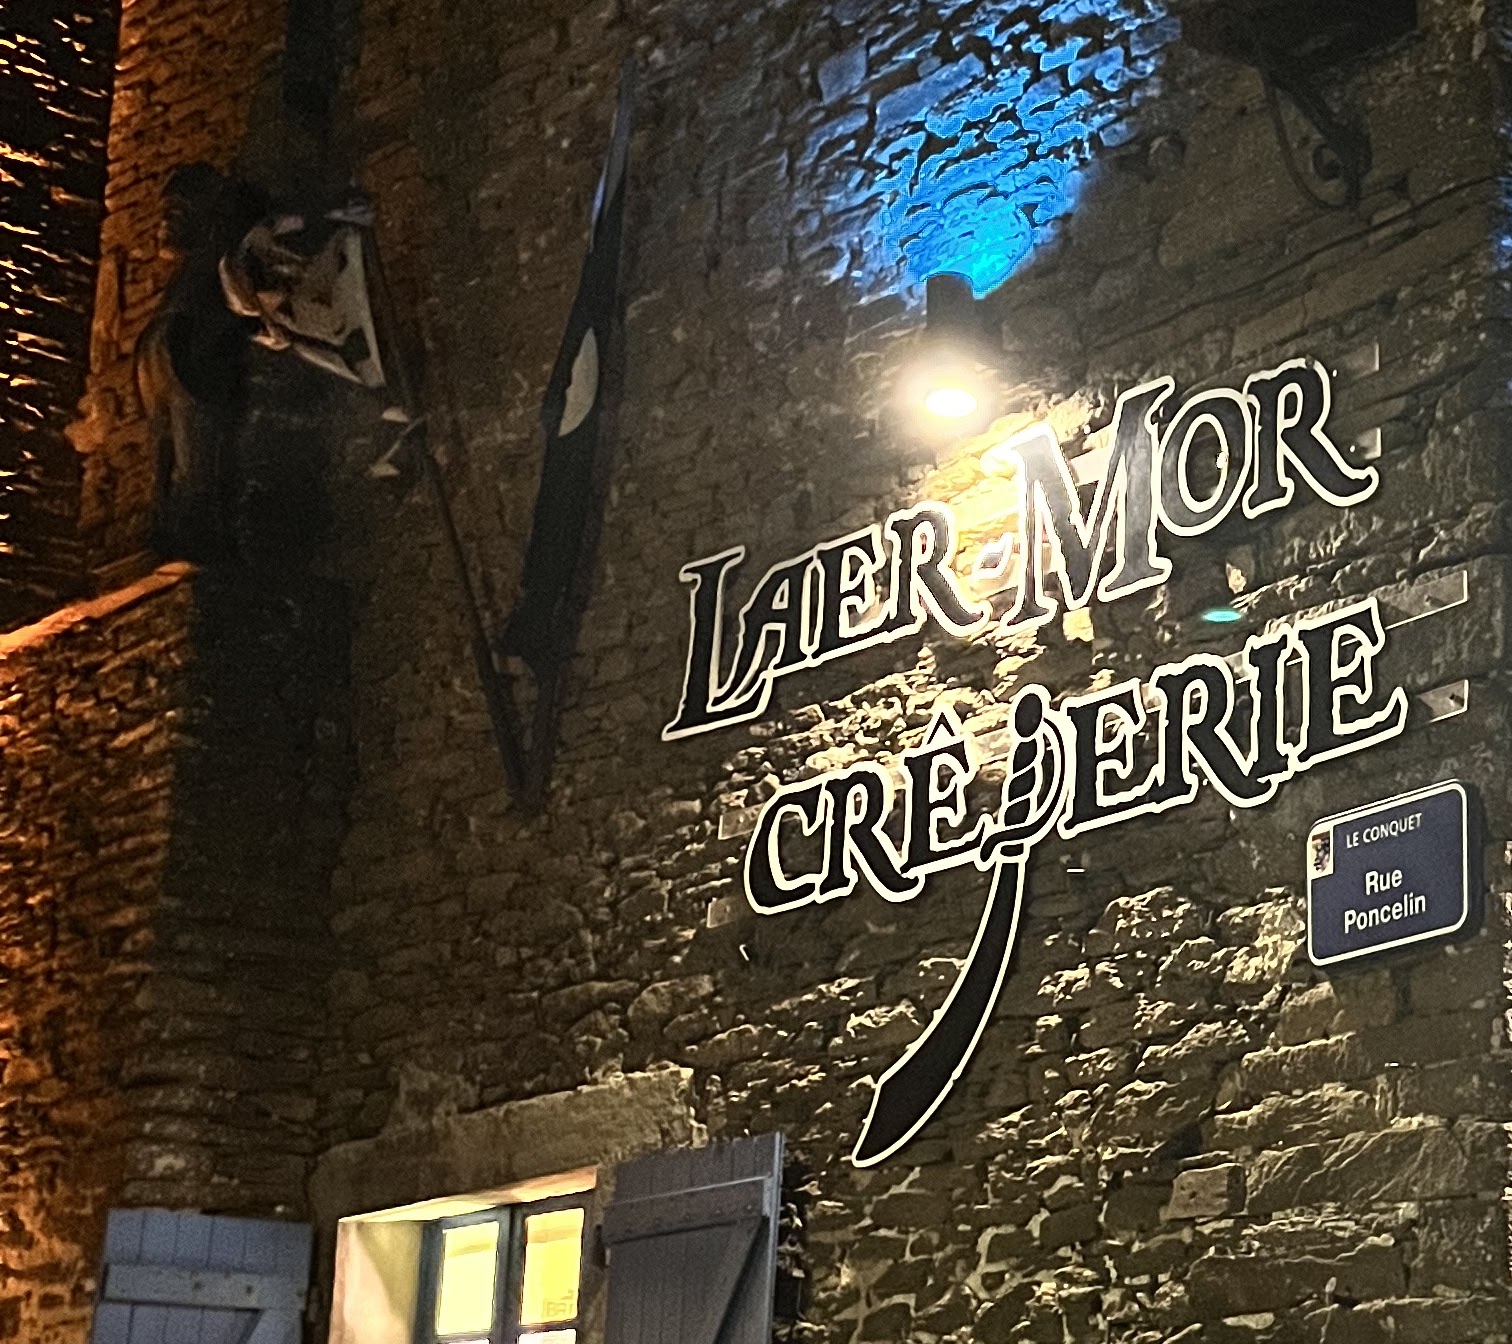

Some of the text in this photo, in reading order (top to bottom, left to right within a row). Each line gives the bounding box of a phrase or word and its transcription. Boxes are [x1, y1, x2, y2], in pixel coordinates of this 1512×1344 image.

[1346, 812, 1423, 849] LE CONQUET
[1365, 869, 1403, 896] Rue
[1344, 892, 1426, 934] Poncelin
